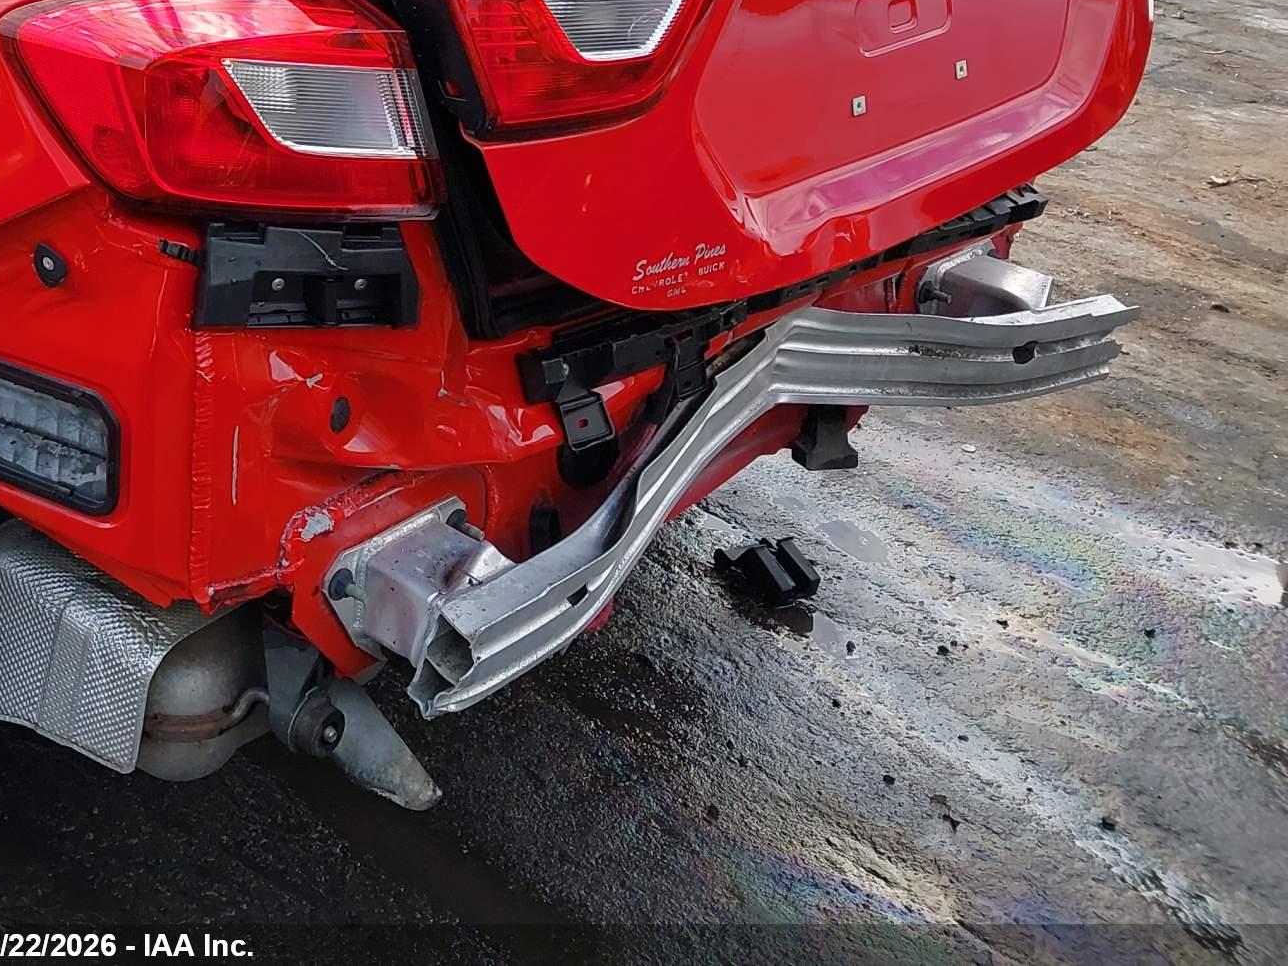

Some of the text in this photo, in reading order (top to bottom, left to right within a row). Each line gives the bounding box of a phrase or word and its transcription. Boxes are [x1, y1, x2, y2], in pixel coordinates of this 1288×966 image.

[632, 243, 726, 281] Southern Pines
[698, 261, 725, 276] BUICK
